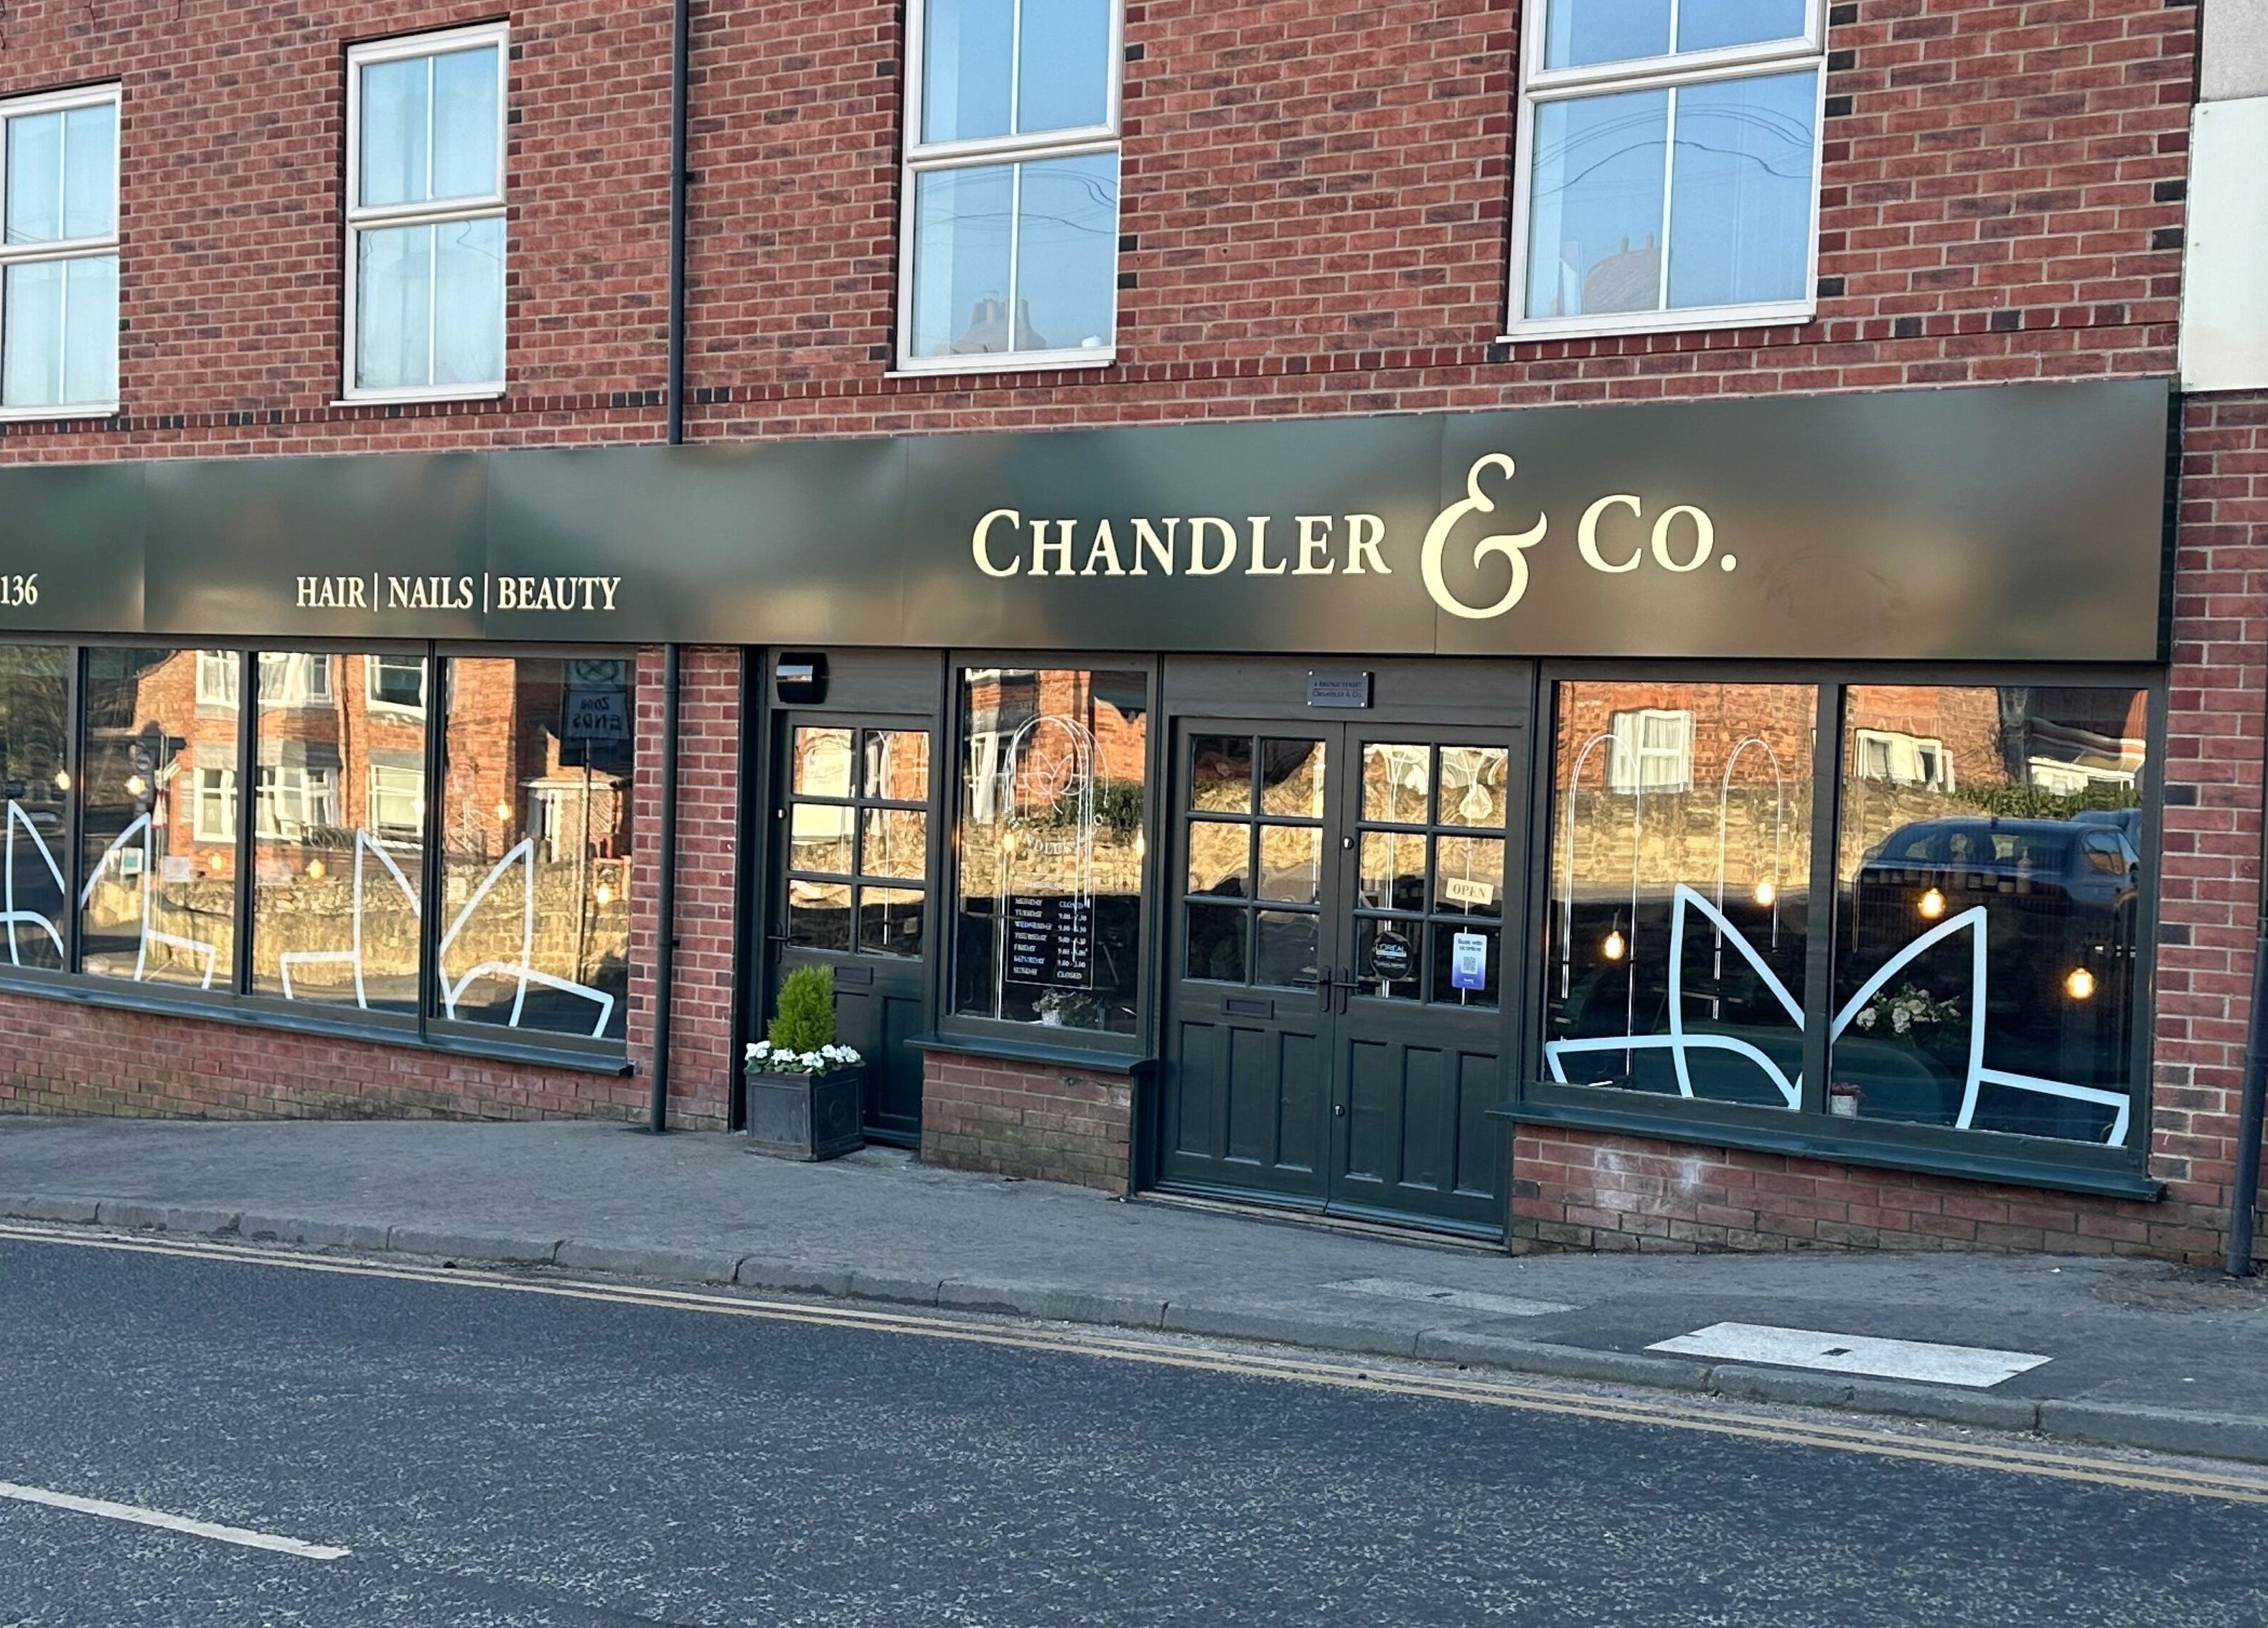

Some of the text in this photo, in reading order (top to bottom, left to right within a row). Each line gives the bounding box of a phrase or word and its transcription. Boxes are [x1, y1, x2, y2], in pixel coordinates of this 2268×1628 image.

[1420, 452, 1548, 619] &
[0, 573, 39, 606] 136
[296, 576, 622, 611] HAIR NAILS BEAUTY
[1453, 883, 1486, 899] OPEN
